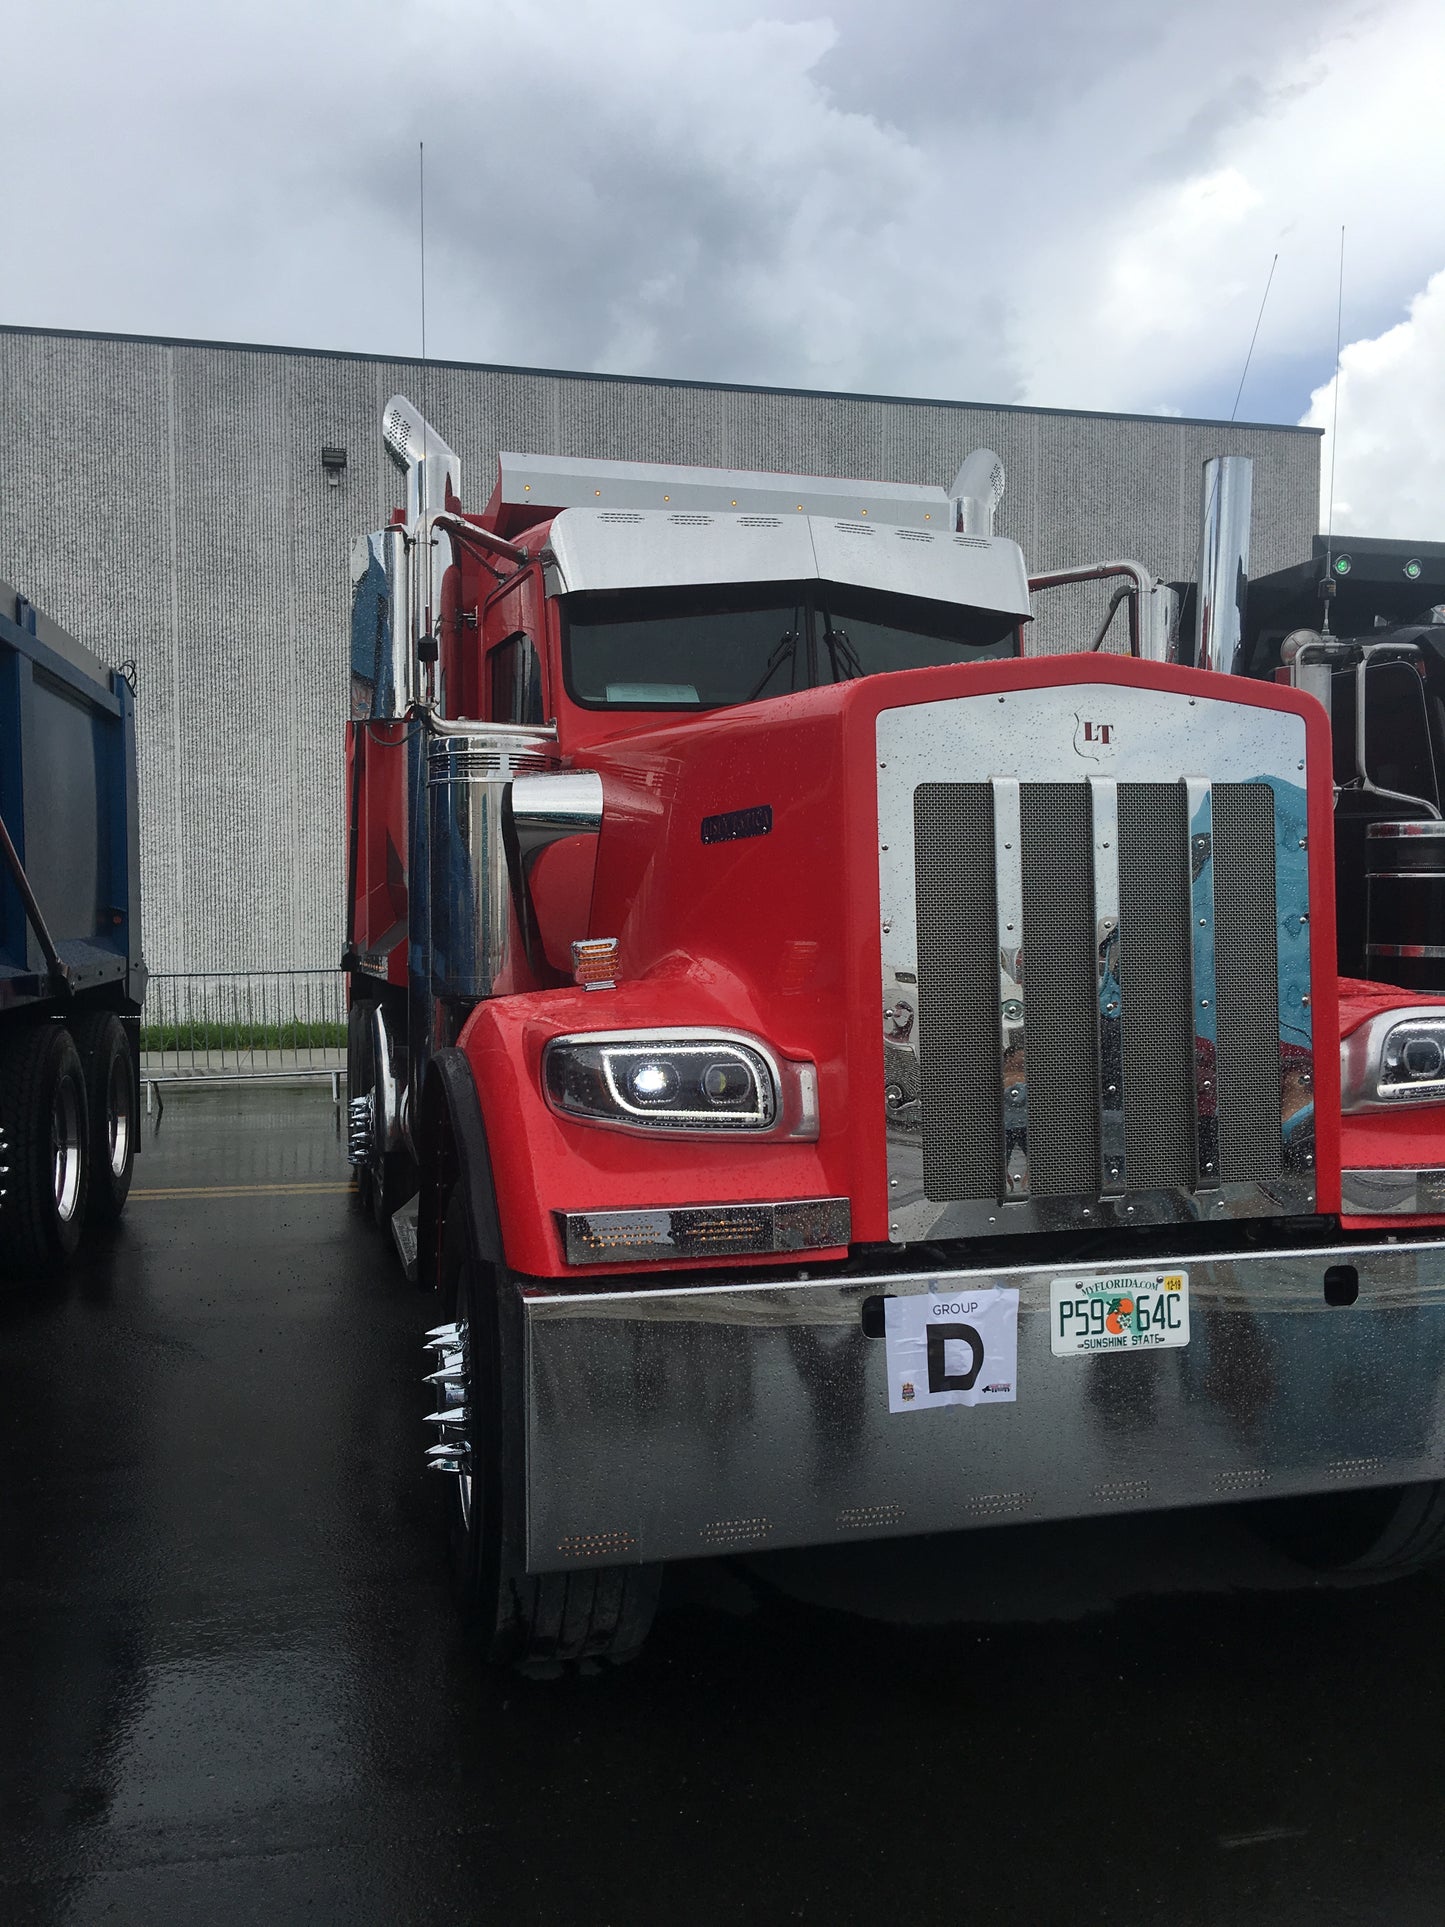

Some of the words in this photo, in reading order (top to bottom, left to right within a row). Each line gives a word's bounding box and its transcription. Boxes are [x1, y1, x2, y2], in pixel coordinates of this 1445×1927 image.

[1083, 722, 1114, 744] LT
[932, 1302, 978, 1315] GROUP
[1083, 1336, 1127, 1349] SUNSHINE
[1132, 1333, 1160, 1345] STATE
[926, 1323, 984, 1393] D
